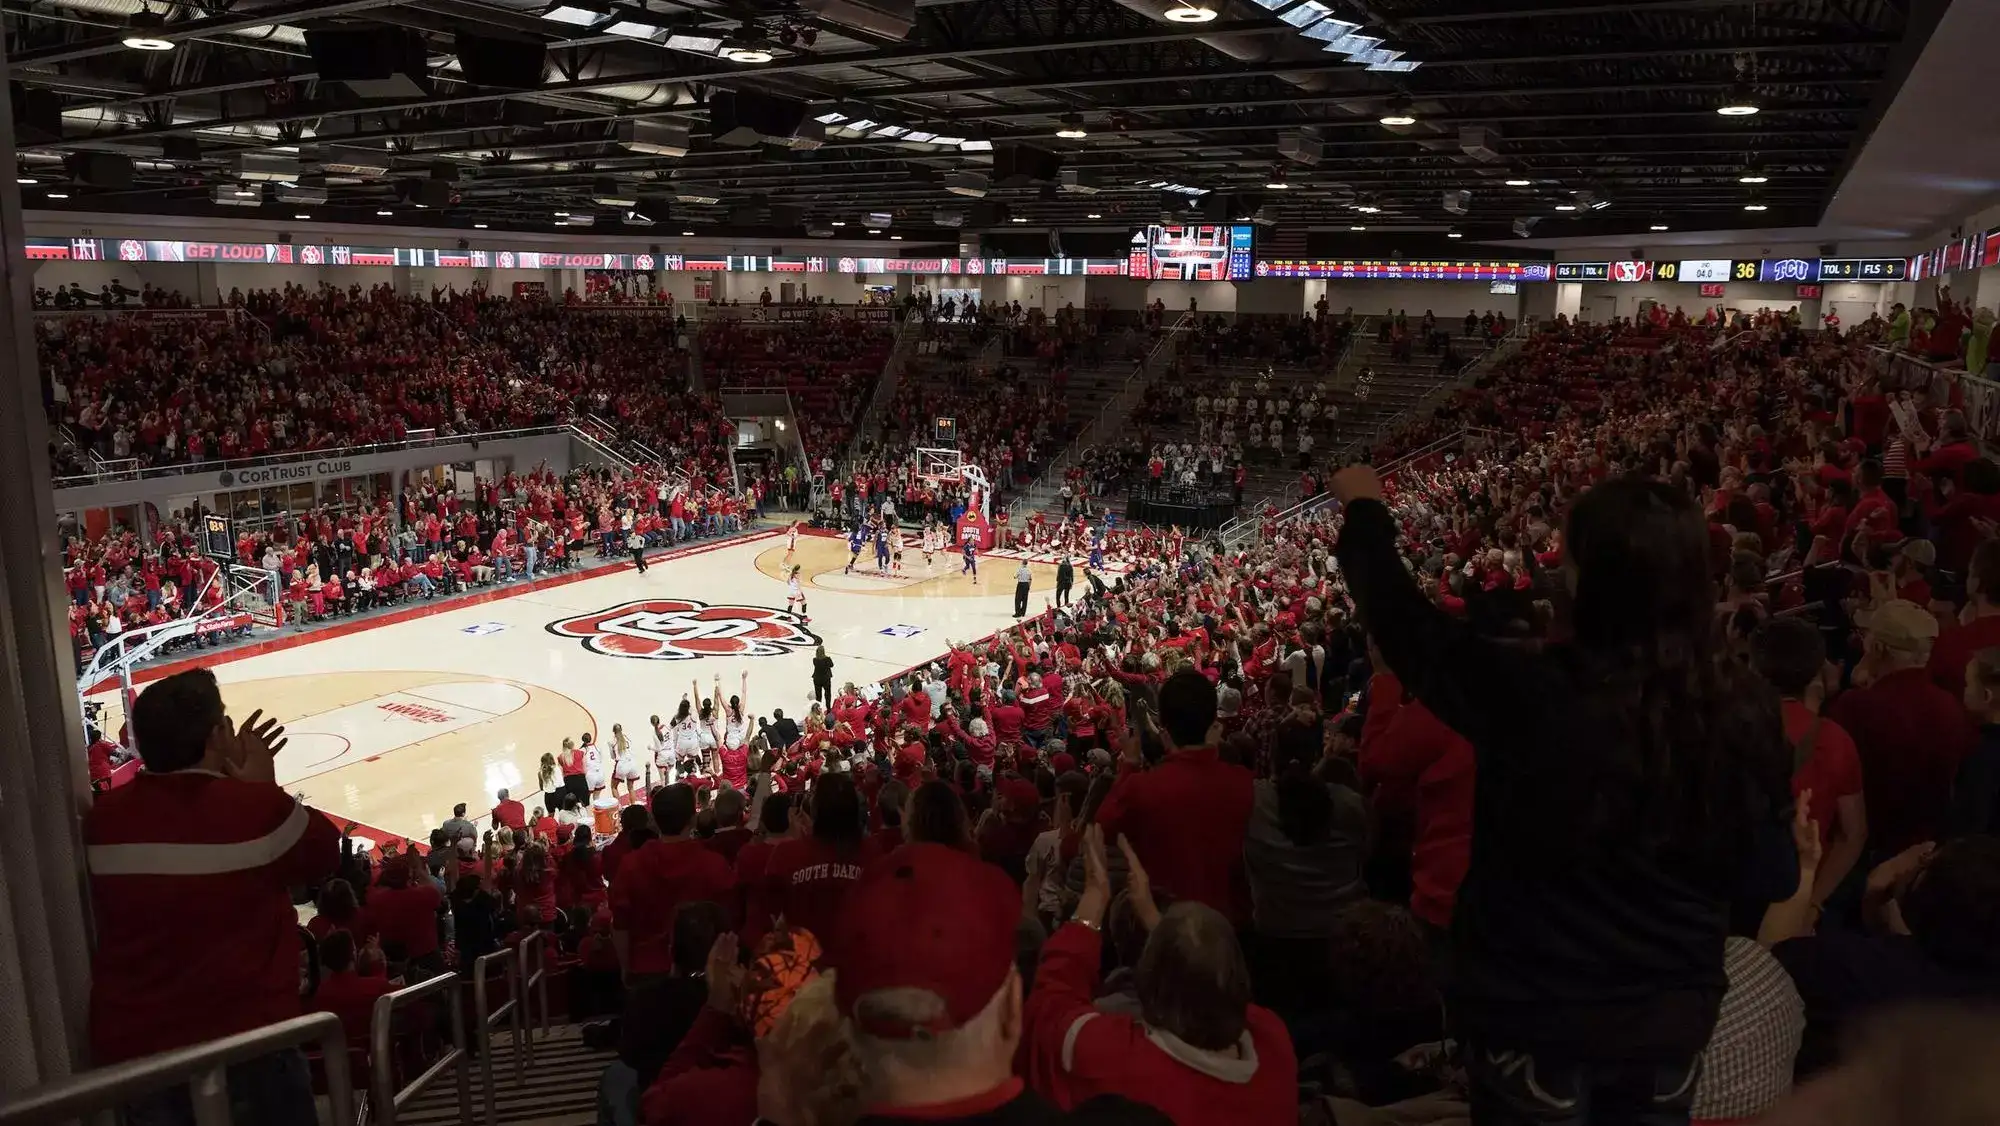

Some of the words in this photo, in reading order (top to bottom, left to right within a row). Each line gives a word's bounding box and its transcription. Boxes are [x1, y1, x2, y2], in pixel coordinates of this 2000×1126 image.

[186, 244, 218, 258] GET
[222, 245, 265, 259] LOUD
[540, 255, 562, 266] GET
[564, 255, 603, 267] LOUD
[887, 260, 909, 270] GET
[911, 260, 941, 271] LOUD
[1523, 265, 1547, 278] TCU
[1560, 267, 1570, 275] FLS
[1586, 267, 1597, 275] TOL
[1597, 267, 1603, 275] 4
[1658, 264, 1675, 279] 40
[1696, 269, 1713, 278] 04.0
[1736, 263, 1756, 279] 36
[1773, 259, 1809, 281] TCU
[1824, 265, 1840, 274] TOL
[1844, 265, 1851, 274] 3
[1864, 264, 1881, 274] FLS
[1886, 265, 1893, 274] 3
[317, 461, 352, 475] CLUB
[682, 722, 692, 731] 34
[589, 751, 596, 761] 2
[791, 863, 829, 886] SOUTH
[832, 862, 865, 880] DAKO
